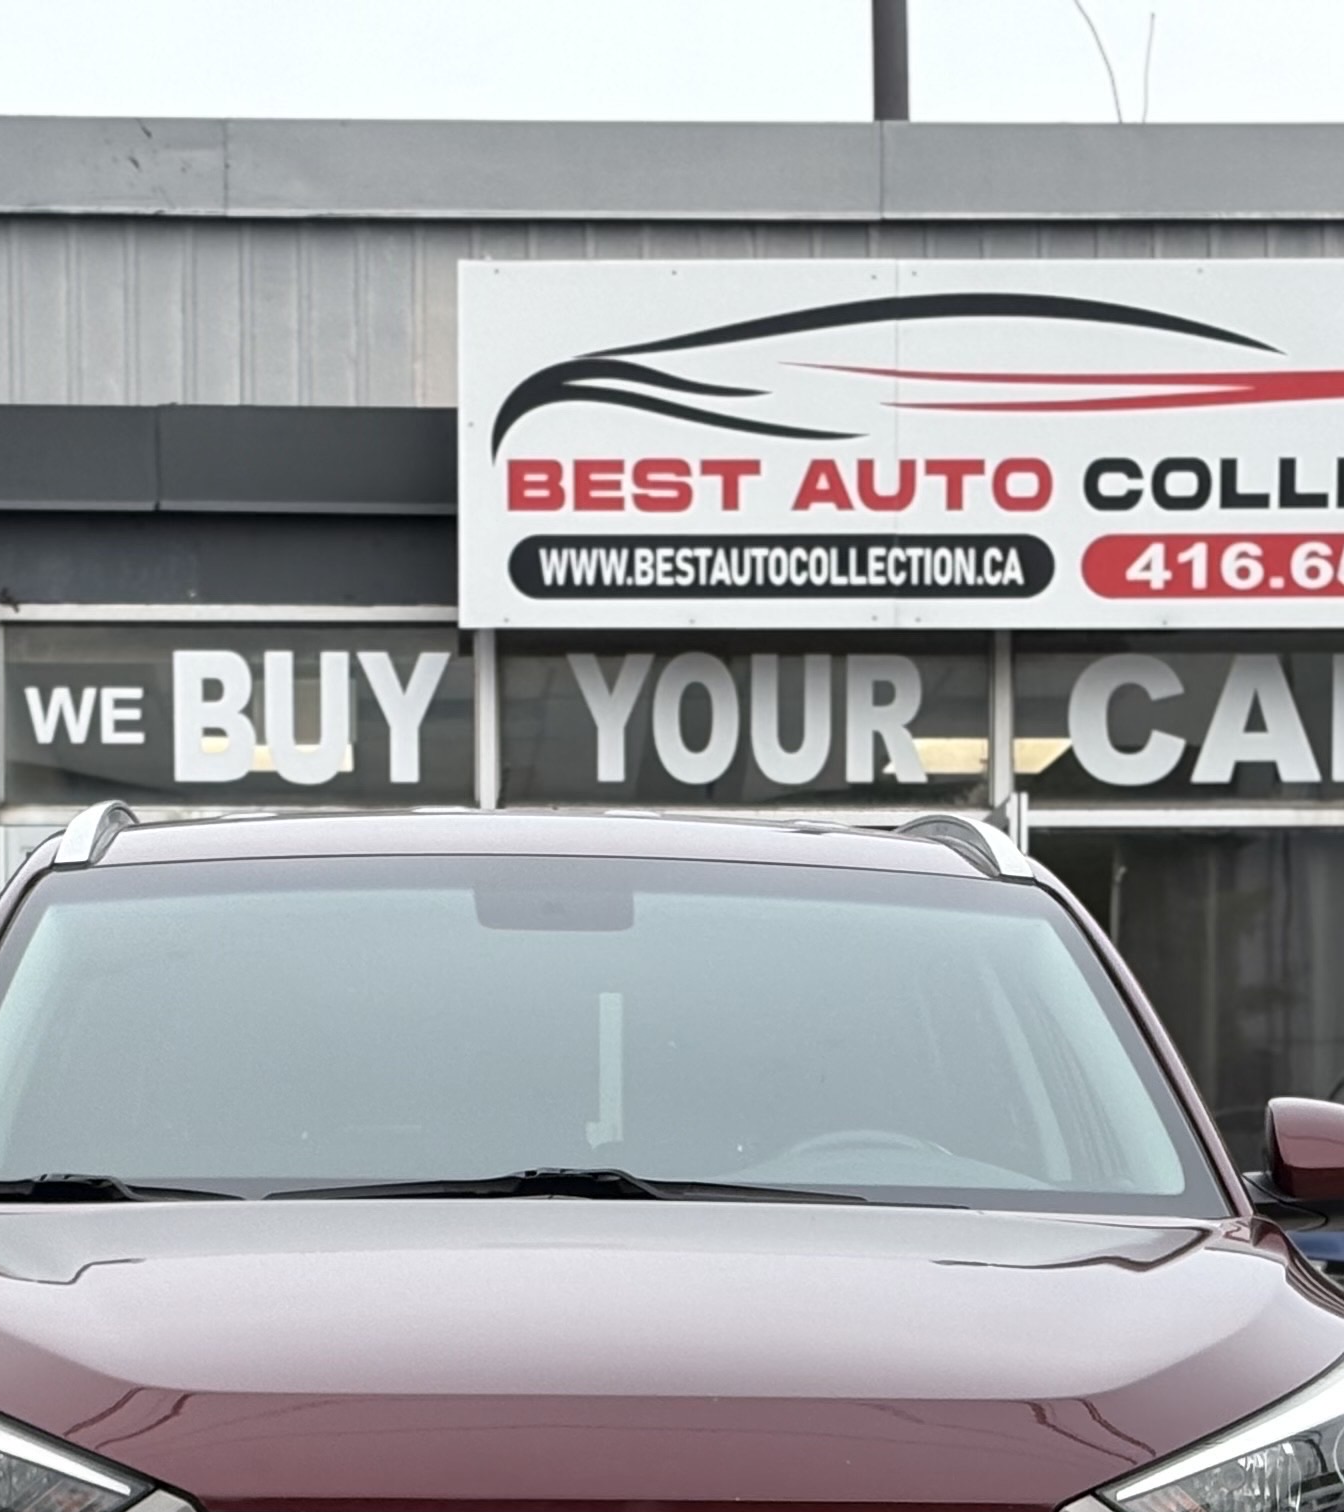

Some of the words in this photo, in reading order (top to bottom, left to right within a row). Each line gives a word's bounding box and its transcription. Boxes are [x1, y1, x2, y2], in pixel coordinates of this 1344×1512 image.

[507, 457, 761, 513] BEST
[793, 457, 1053, 513] AUTO
[539, 546, 1025, 586] WWW.BESTAUTOCOLLECTION.CA
[24, 686, 146, 745] WE
[172, 650, 451, 785] BUY
[566, 651, 928, 785] YOUR
